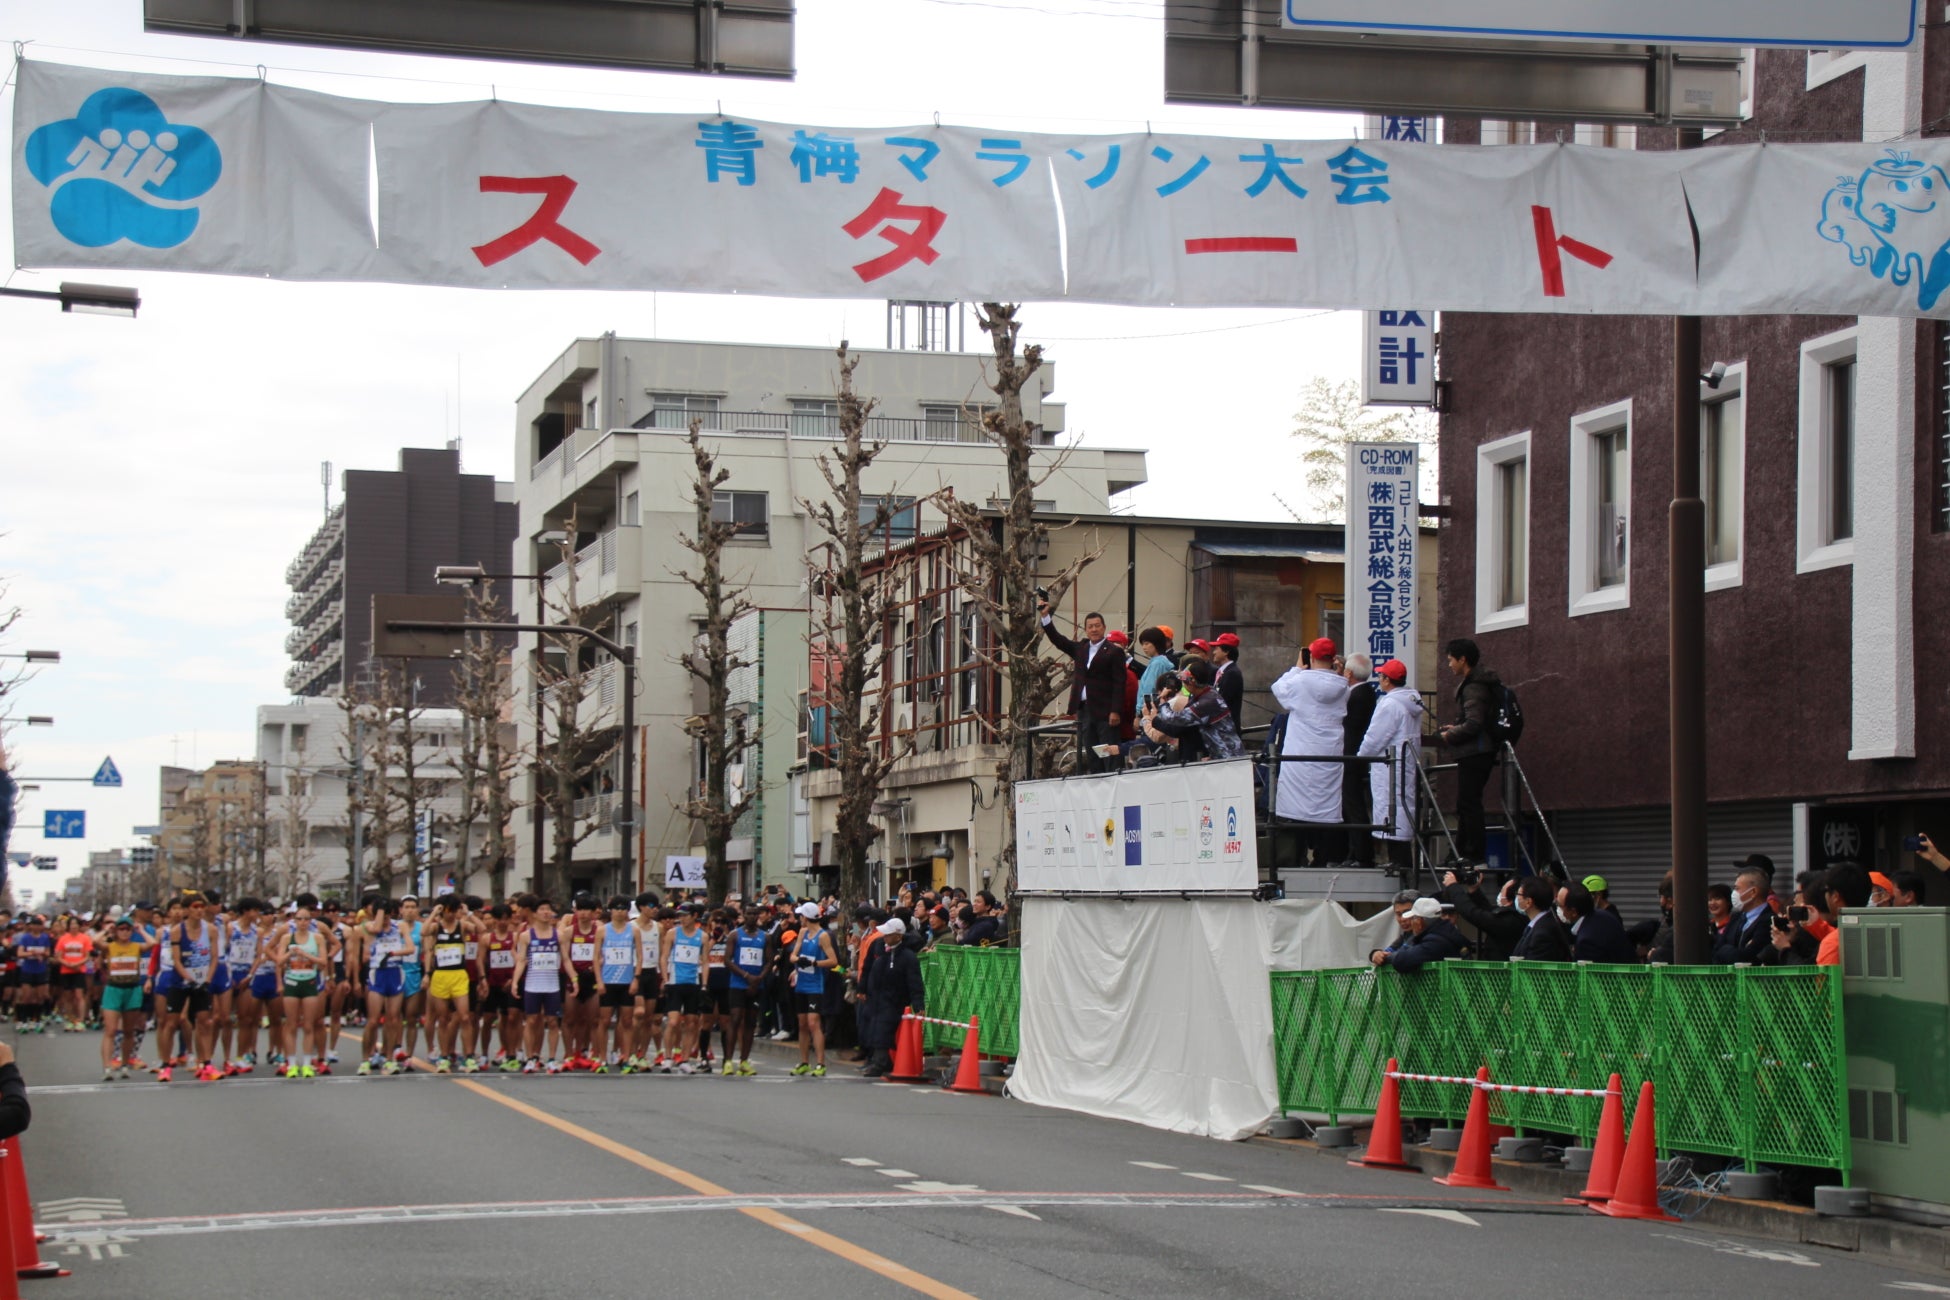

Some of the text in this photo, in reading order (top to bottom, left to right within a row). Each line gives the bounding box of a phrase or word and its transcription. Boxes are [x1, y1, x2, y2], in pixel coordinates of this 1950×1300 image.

[695, 120, 1392, 205] 青梅マラソン大会
[470, 173, 1615, 298] スタート
[1360, 449, 1412, 465] CD-ROM
[669, 861, 685, 882] A
[498, 954, 508, 964] 24
[614, 951, 624, 960] 11
[685, 949, 691, 958] 9
[749, 952, 758, 961] 14
